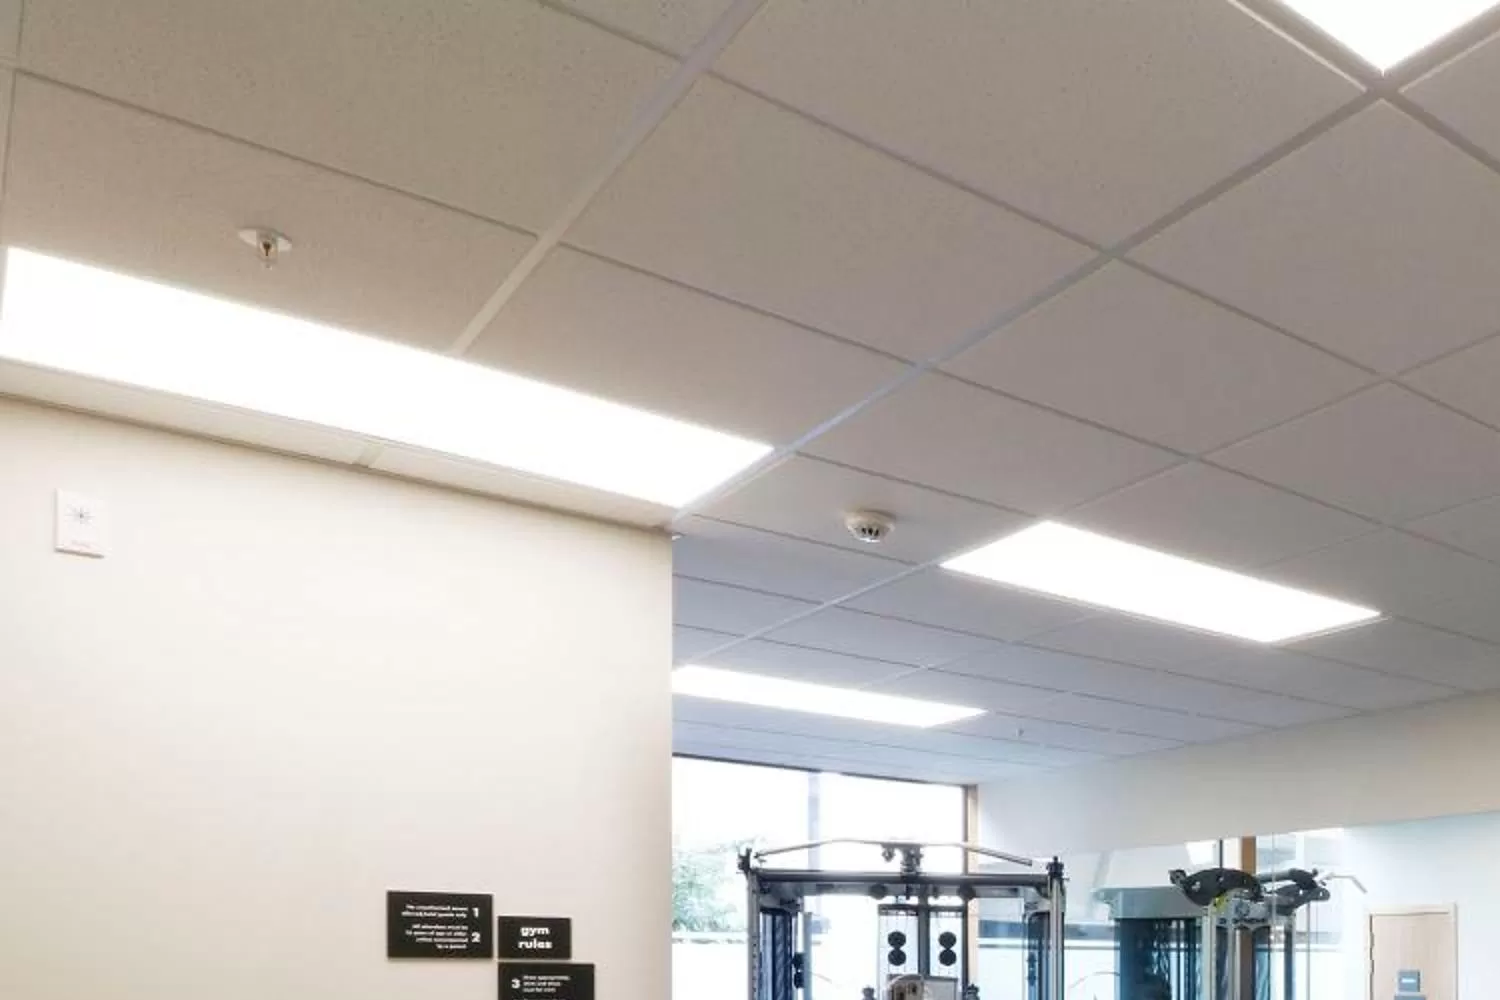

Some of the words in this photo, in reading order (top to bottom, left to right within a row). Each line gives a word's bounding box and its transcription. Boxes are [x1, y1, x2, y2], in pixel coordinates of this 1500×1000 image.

[472, 907, 480, 918] 1
[520, 926, 550, 937] gym
[471, 932, 481, 943] 2
[518, 938, 553, 949] rules
[511, 978, 520, 989] 3
